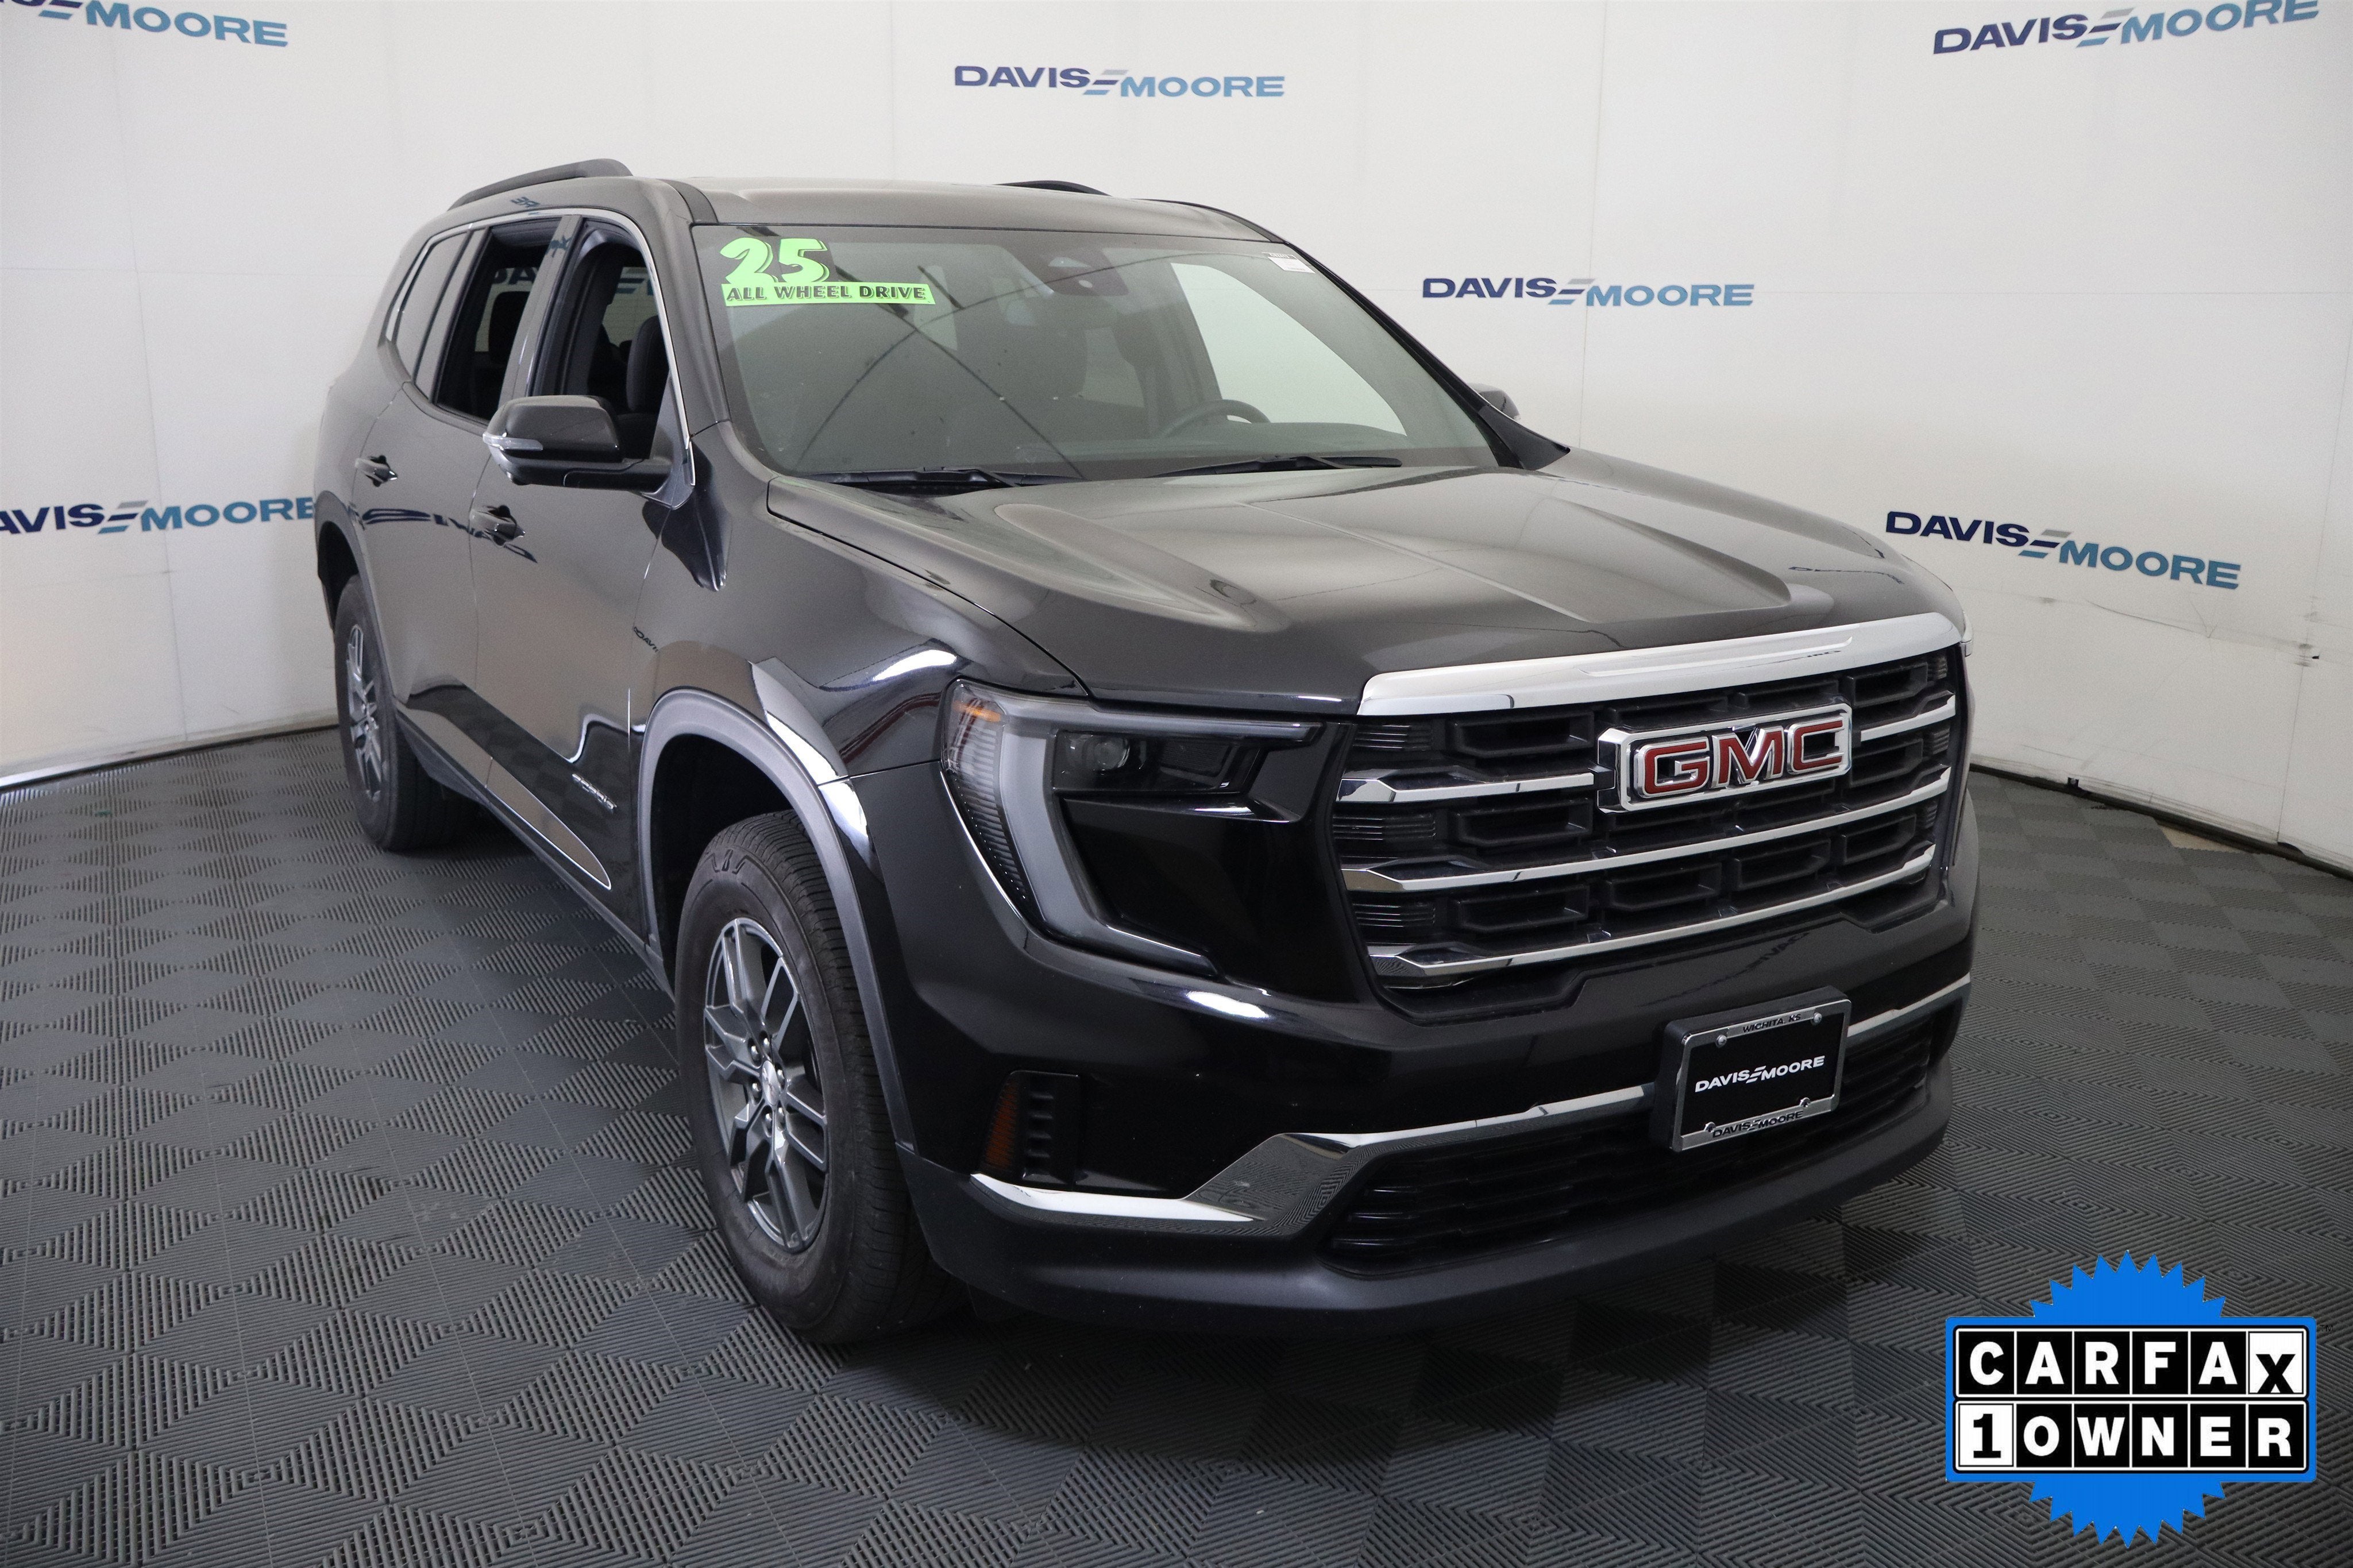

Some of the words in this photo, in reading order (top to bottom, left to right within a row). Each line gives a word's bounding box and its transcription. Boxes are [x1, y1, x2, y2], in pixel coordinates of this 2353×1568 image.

[86, 0, 288, 47] MOORE
[1934, 14, 2088, 55] DAVIS
[2120, 0, 2320, 44] MOORE
[955, 65, 1091, 88] DAVIS
[1120, 75, 1285, 98] MOORE
[720, 237, 830, 283] 25
[727, 287, 767, 300] ALL
[774, 285, 851, 299] WHEEL
[859, 285, 926, 299] DRIVE
[1422, 277, 1557, 298] DAVIS
[1586, 284, 1754, 307] MOORE
[141, 497, 314, 532] MOORE
[1887, 511, 2028, 546] DAVIS
[2059, 540, 2242, 589] MOORE
[1636, 716, 1844, 798] GMC
[1788, 1014, 1801, 1022] KS
[1695, 1069, 1750, 1092] DAVIS
[1761, 1055, 1825, 1081] MOORE
[1712, 1122, 1751, 1138] DAVIS
[1758, 1111, 1804, 1129] MOORE
